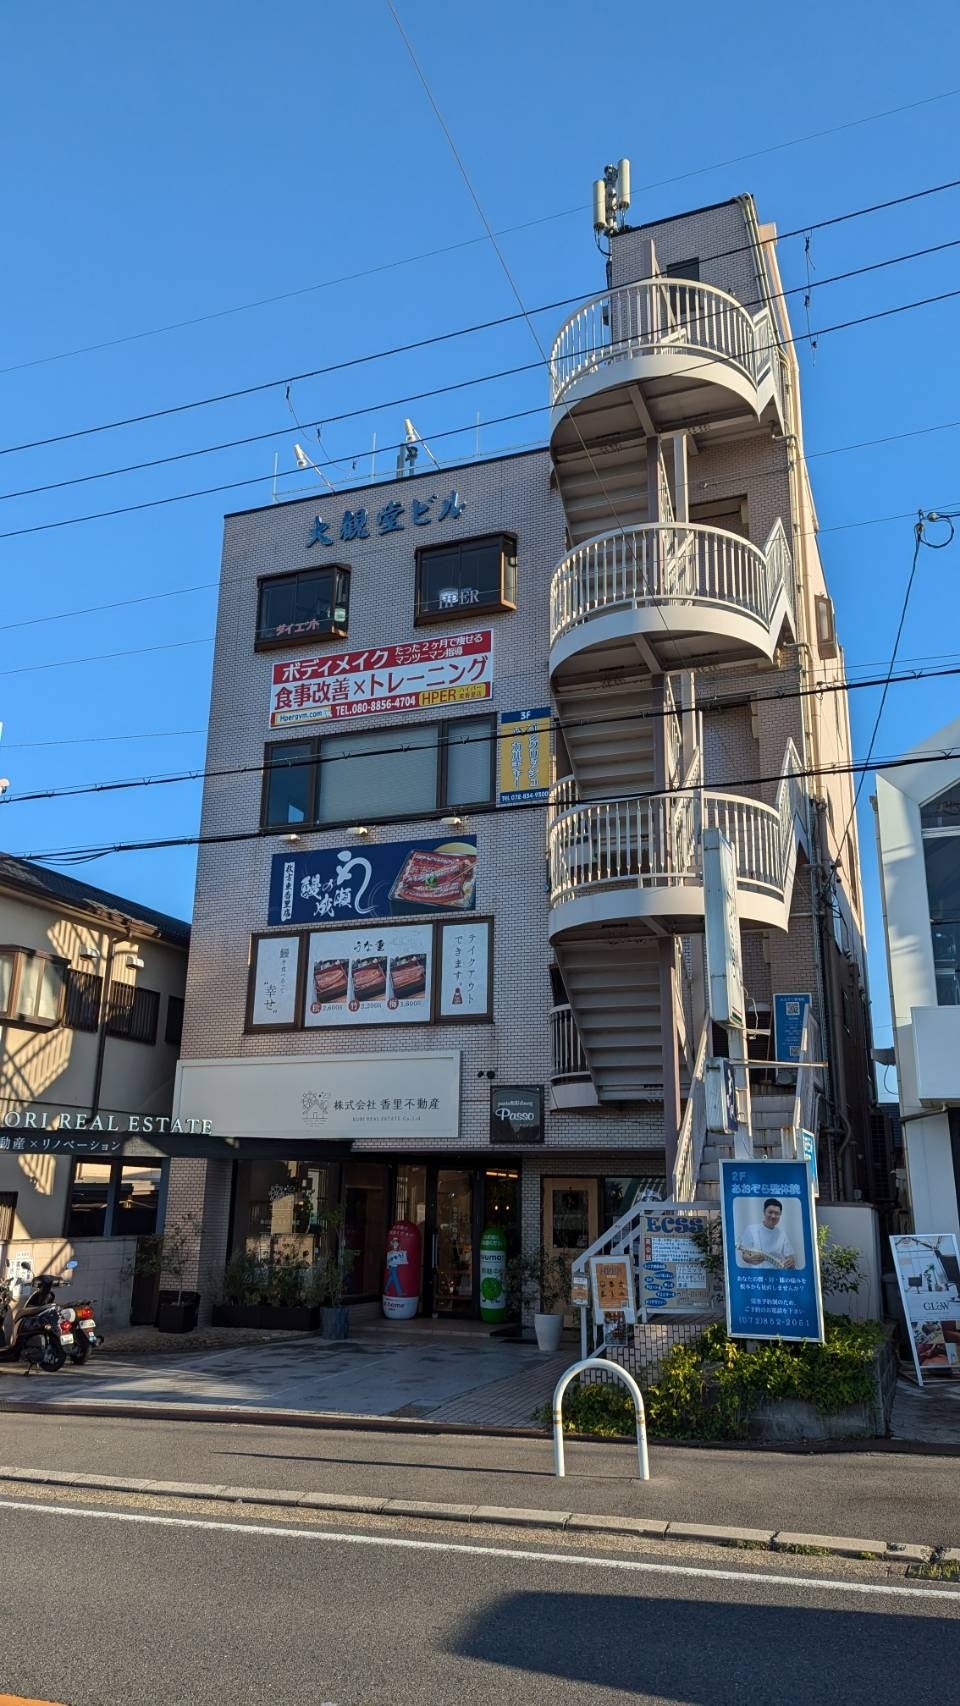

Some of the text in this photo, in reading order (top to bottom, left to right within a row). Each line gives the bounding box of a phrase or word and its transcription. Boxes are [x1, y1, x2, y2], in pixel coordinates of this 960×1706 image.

[306, 490, 467, 548] 大観堂ビル
[275, 619, 320, 636] ダイエット
[282, 650, 388, 681] ボディメイク
[395, 646, 463, 665] マンツーマン指導
[274, 655, 488, 711] 食事改善×トレーニング
[336, 695, 416, 717] TEL.080-8856-4704
[422, 688, 457, 705] HPER
[467, 933, 476, 1005] テイクアウト
[334, 1098, 441, 1110] 株式会社 香里不動産
[495, 1107, 535, 1121] Passo
[59, 1112, 119, 1131] REAL
[128, 1115, 213, 1135] ESTATE
